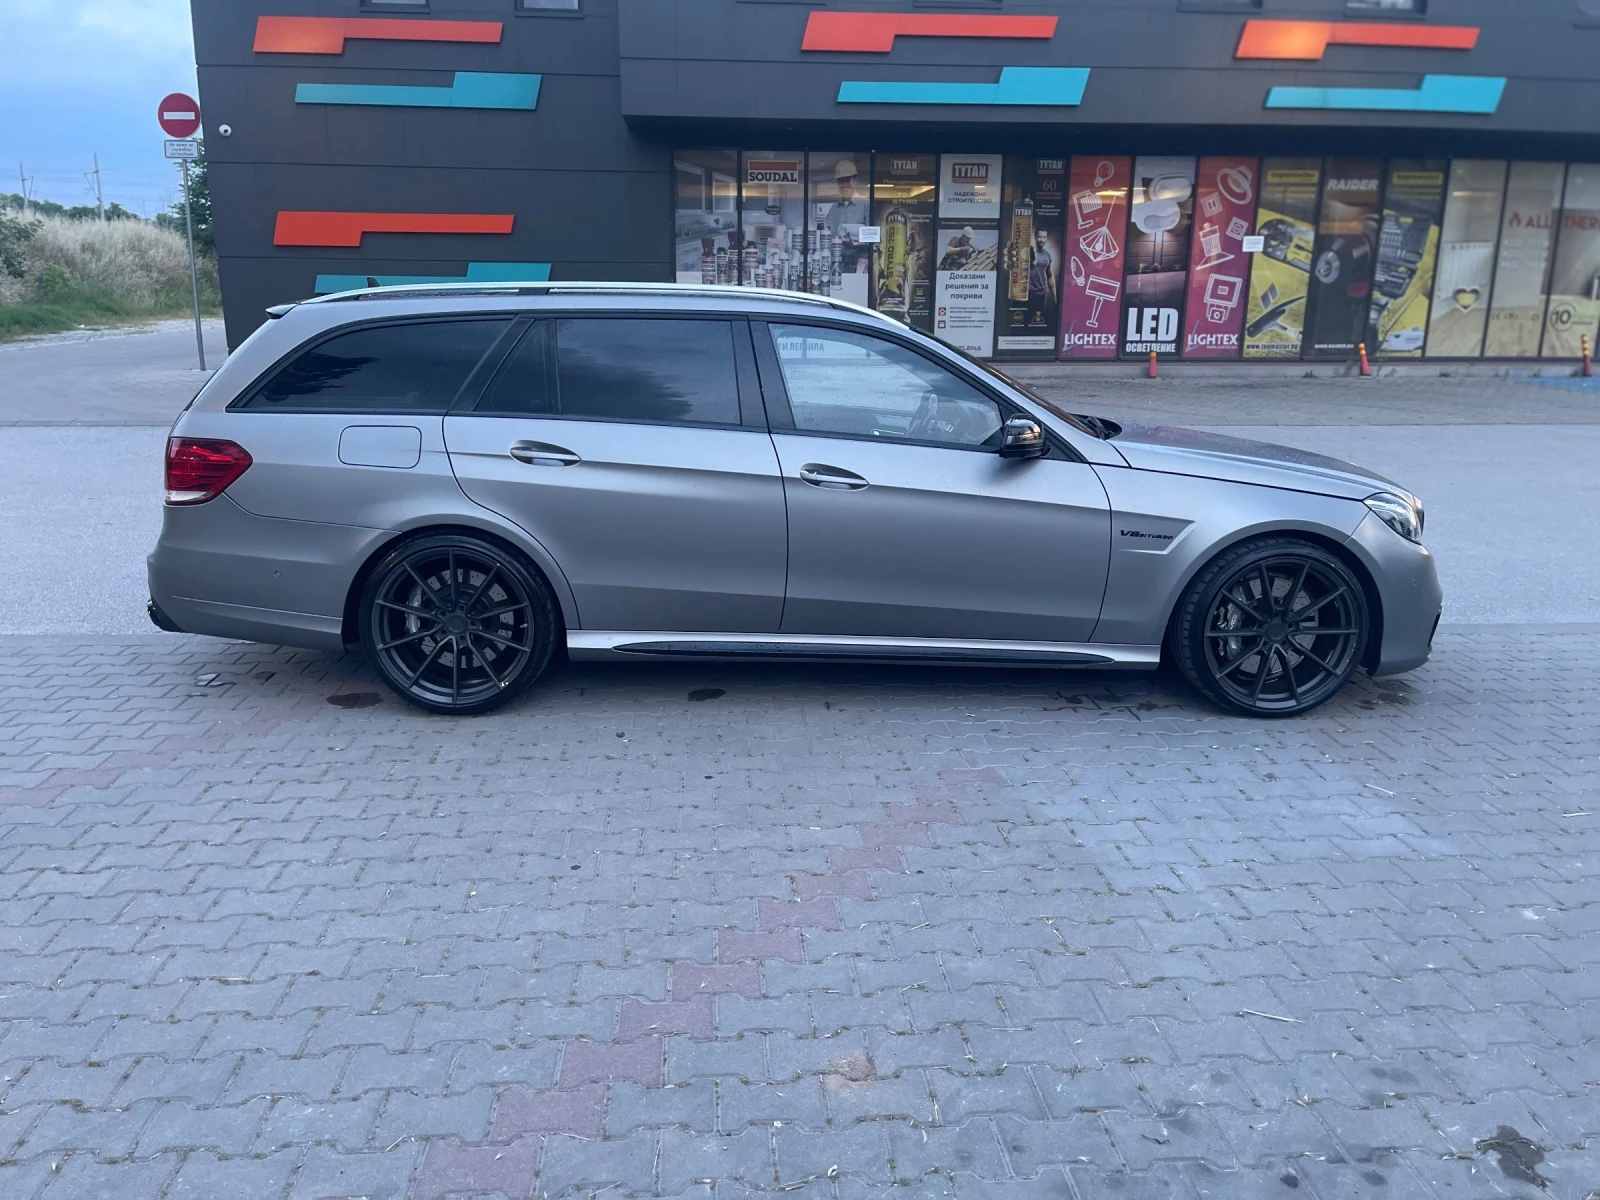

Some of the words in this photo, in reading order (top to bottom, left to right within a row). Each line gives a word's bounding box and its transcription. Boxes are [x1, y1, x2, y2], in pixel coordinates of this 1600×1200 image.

[893, 160, 918, 170] TYTAN
[954, 165, 986, 177] TYTAN
[1040, 160, 1062, 170] TYTAN
[749, 172, 798, 182] SOUDAL
[1042, 179, 1057, 191] 60
[1327, 178, 1379, 190] RAIDER
[886, 246, 894, 278] STYRO
[1552, 310, 1571, 324] 10
[1126, 307, 1178, 341] LED
[1065, 334, 1116, 344] LIGHTEX
[1188, 333, 1239, 345] LIGHTEX
[1126, 342, 1176, 352] ОСВЕТЛЕНИЕ
